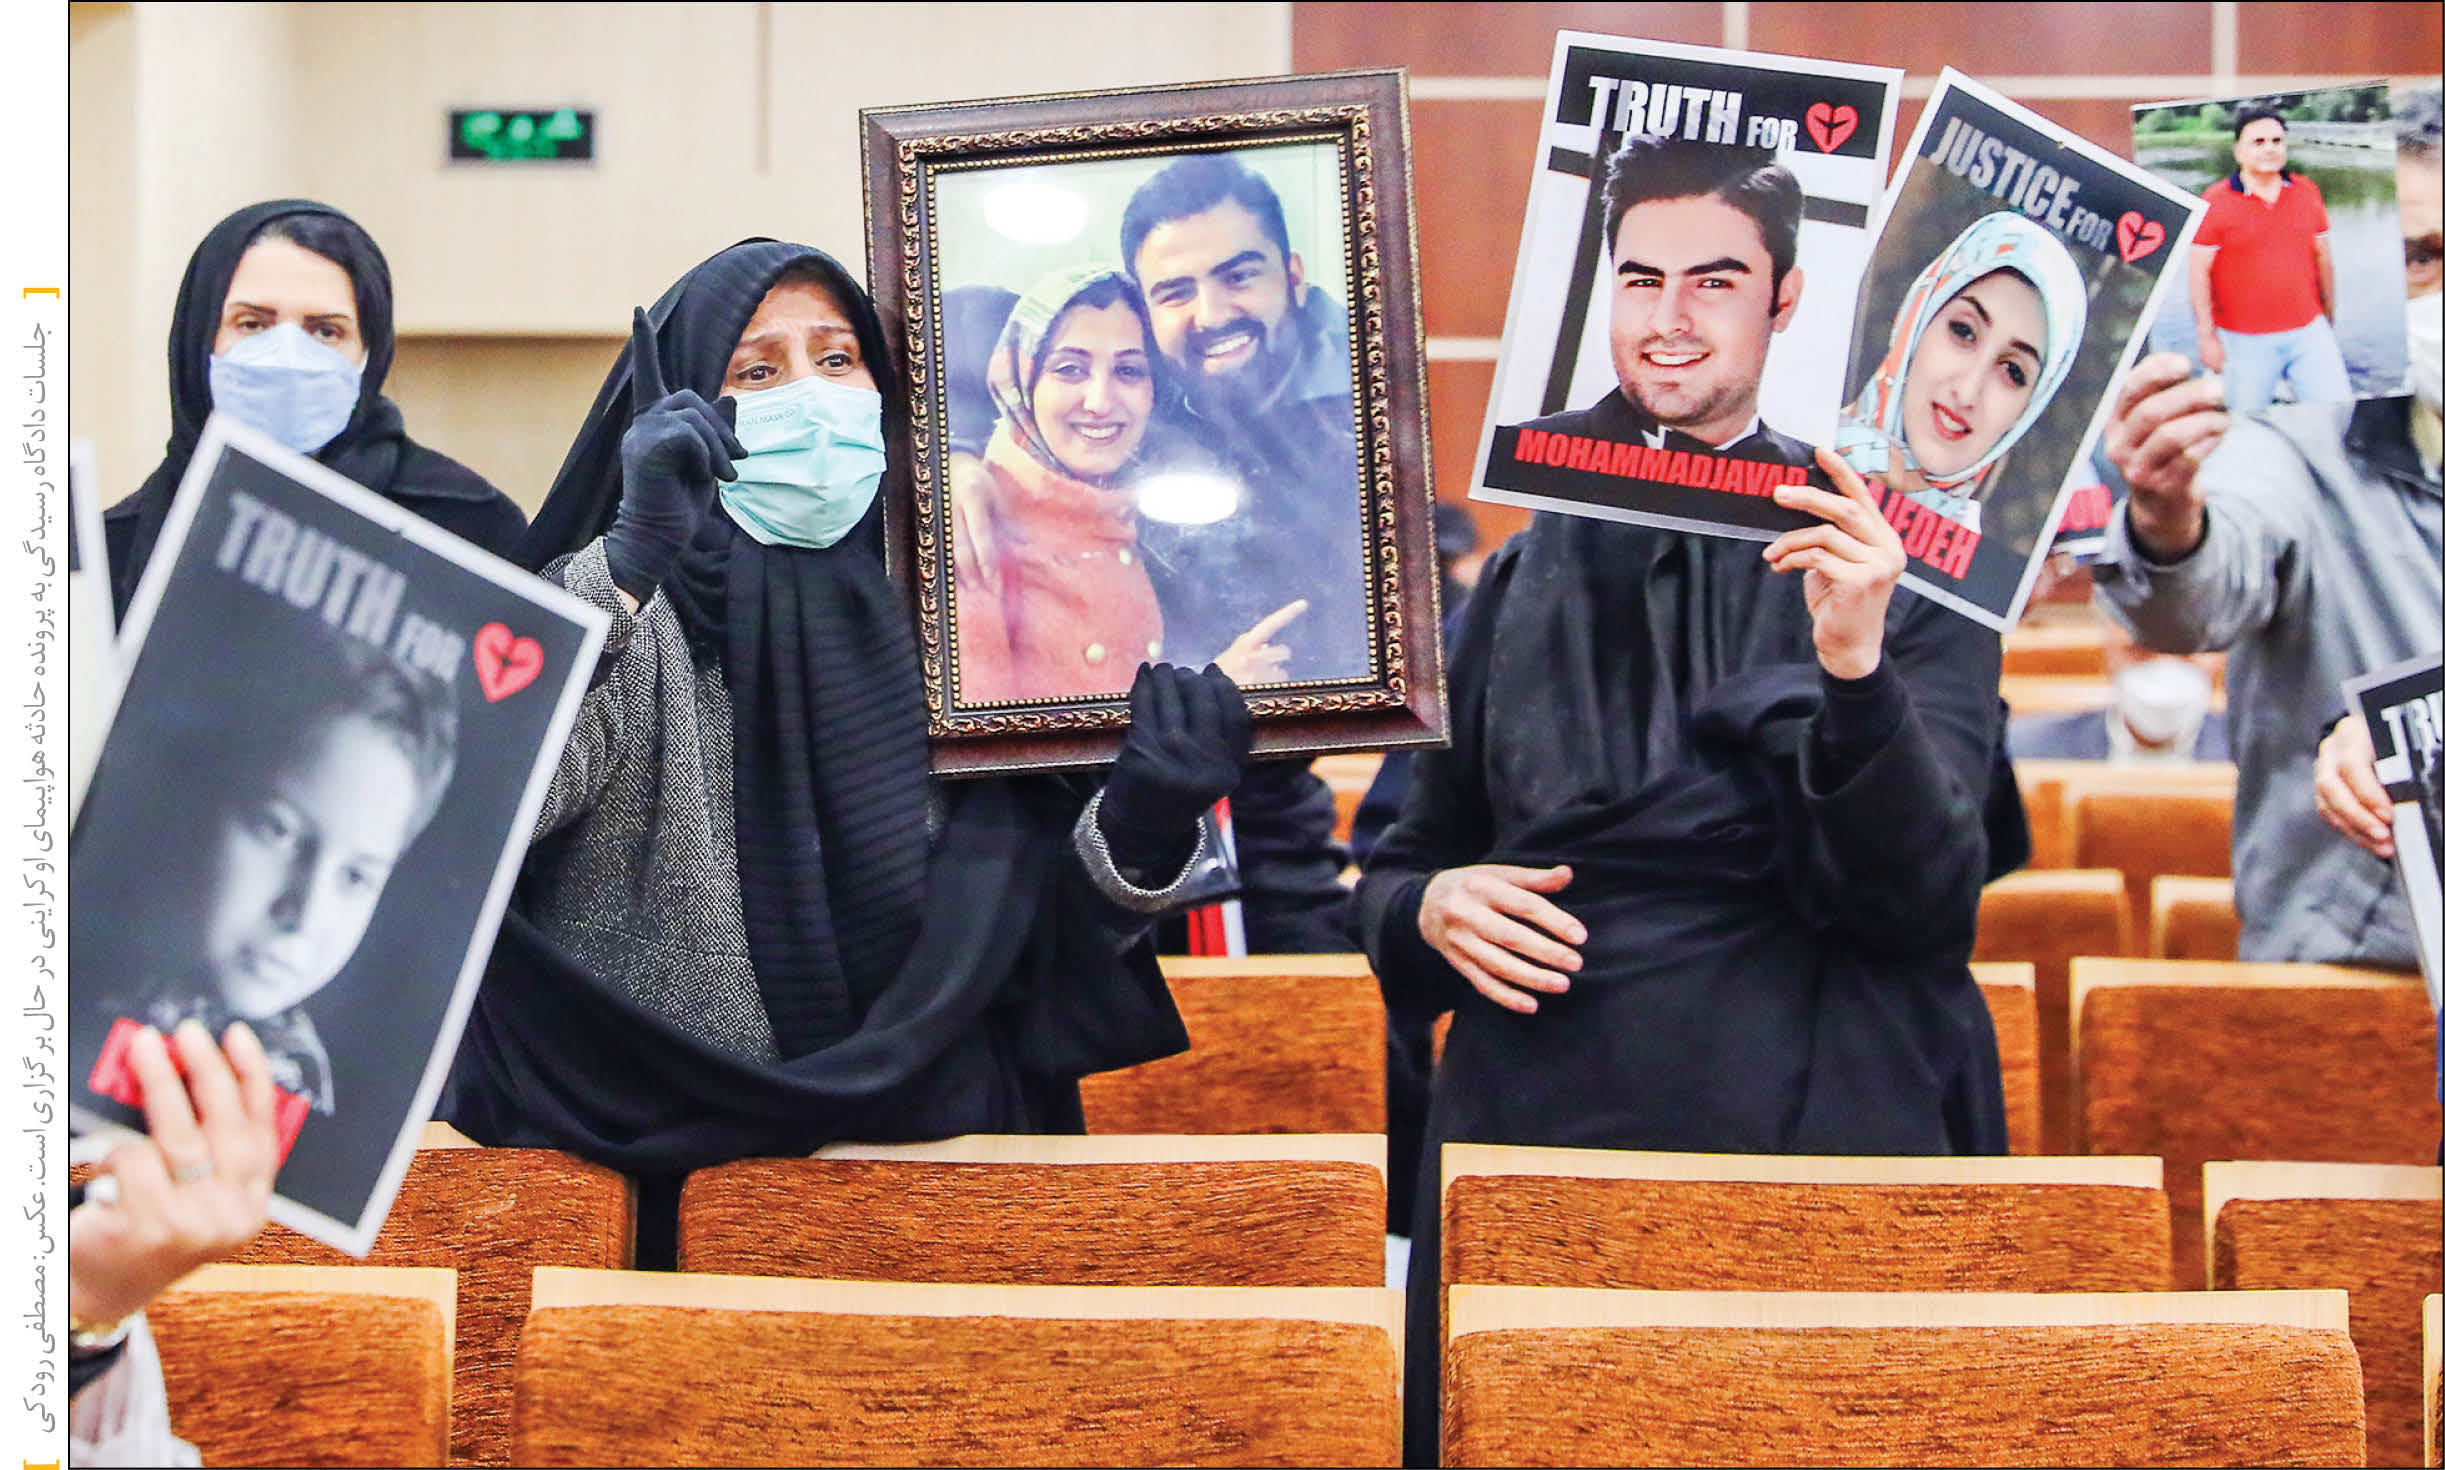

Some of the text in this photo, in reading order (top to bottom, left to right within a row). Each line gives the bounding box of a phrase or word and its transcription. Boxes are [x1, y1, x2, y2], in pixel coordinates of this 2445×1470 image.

[1588, 75, 1800, 153] TRUTH FOR
[1929, 116, 2115, 252] JUSTICE FOR
[216, 491, 466, 684] TRUTH FOR
